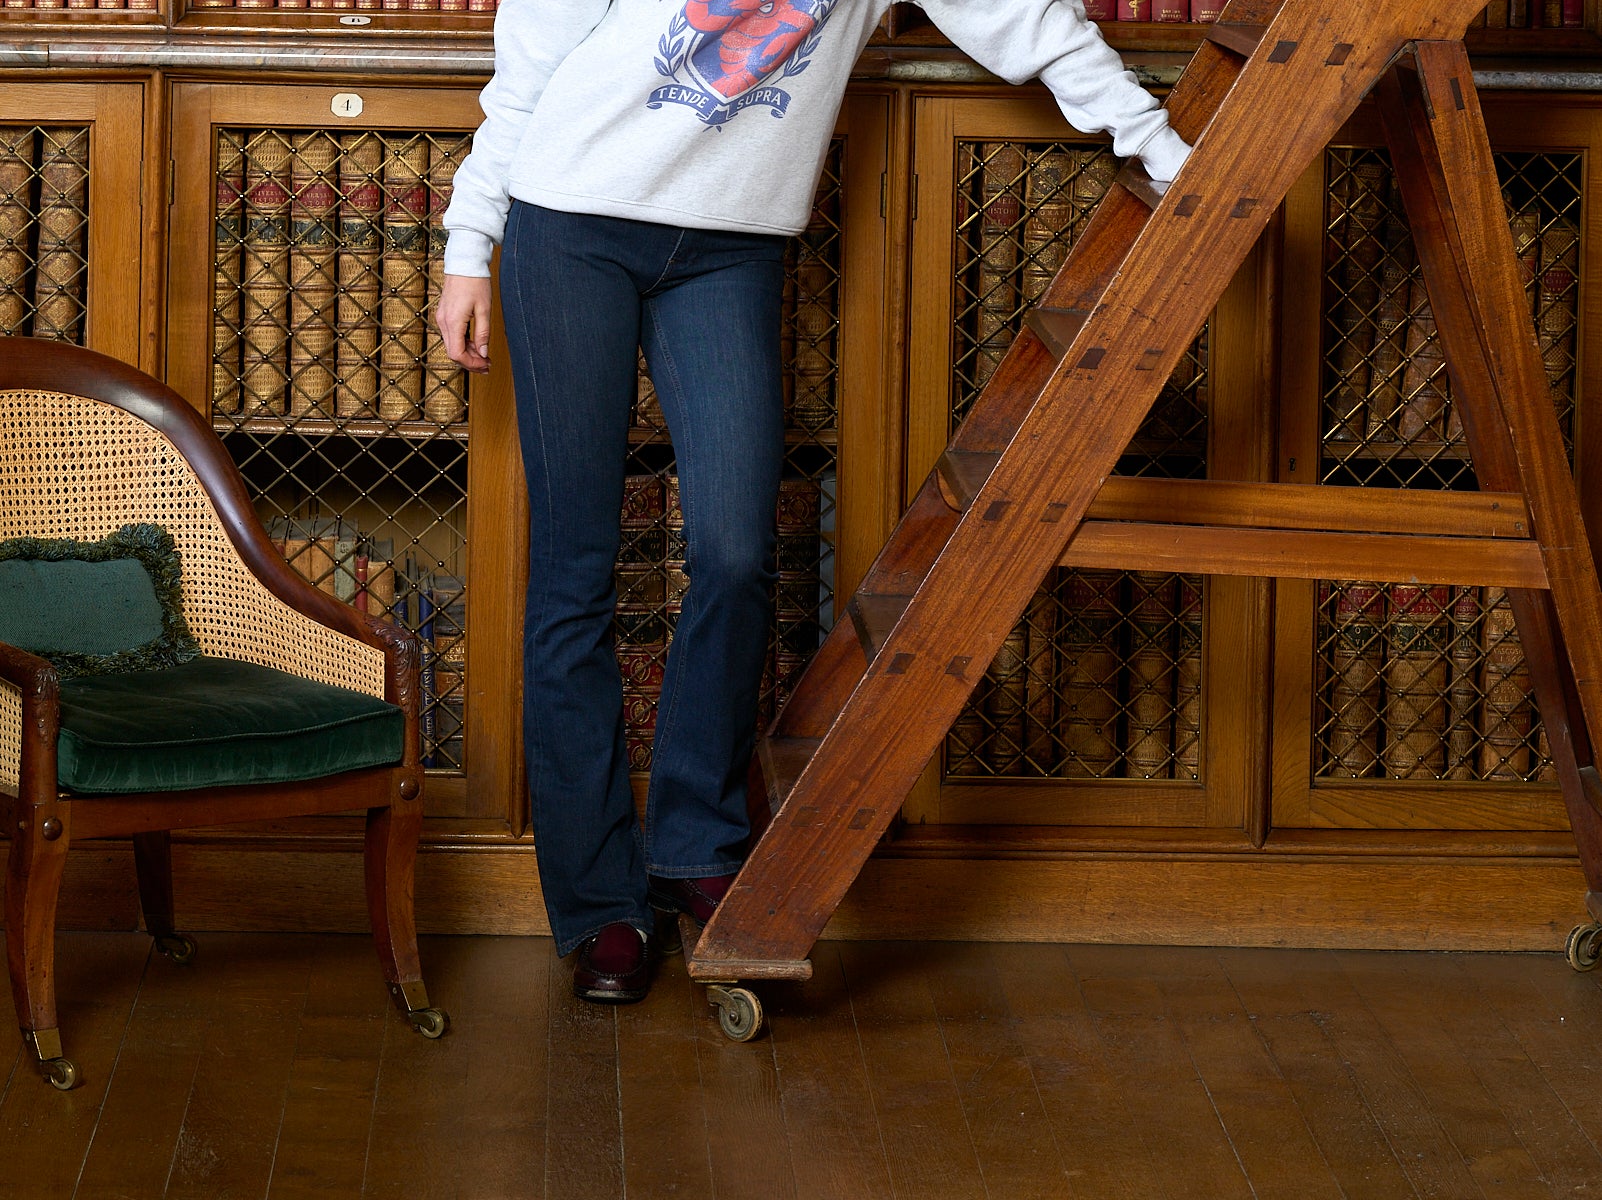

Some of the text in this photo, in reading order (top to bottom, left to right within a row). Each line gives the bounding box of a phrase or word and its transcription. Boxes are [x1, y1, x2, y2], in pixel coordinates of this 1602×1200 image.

[340, 98, 352, 111] 4
[658, 86, 710, 110] TENDE
[736, 89, 782, 110] SUPRA
